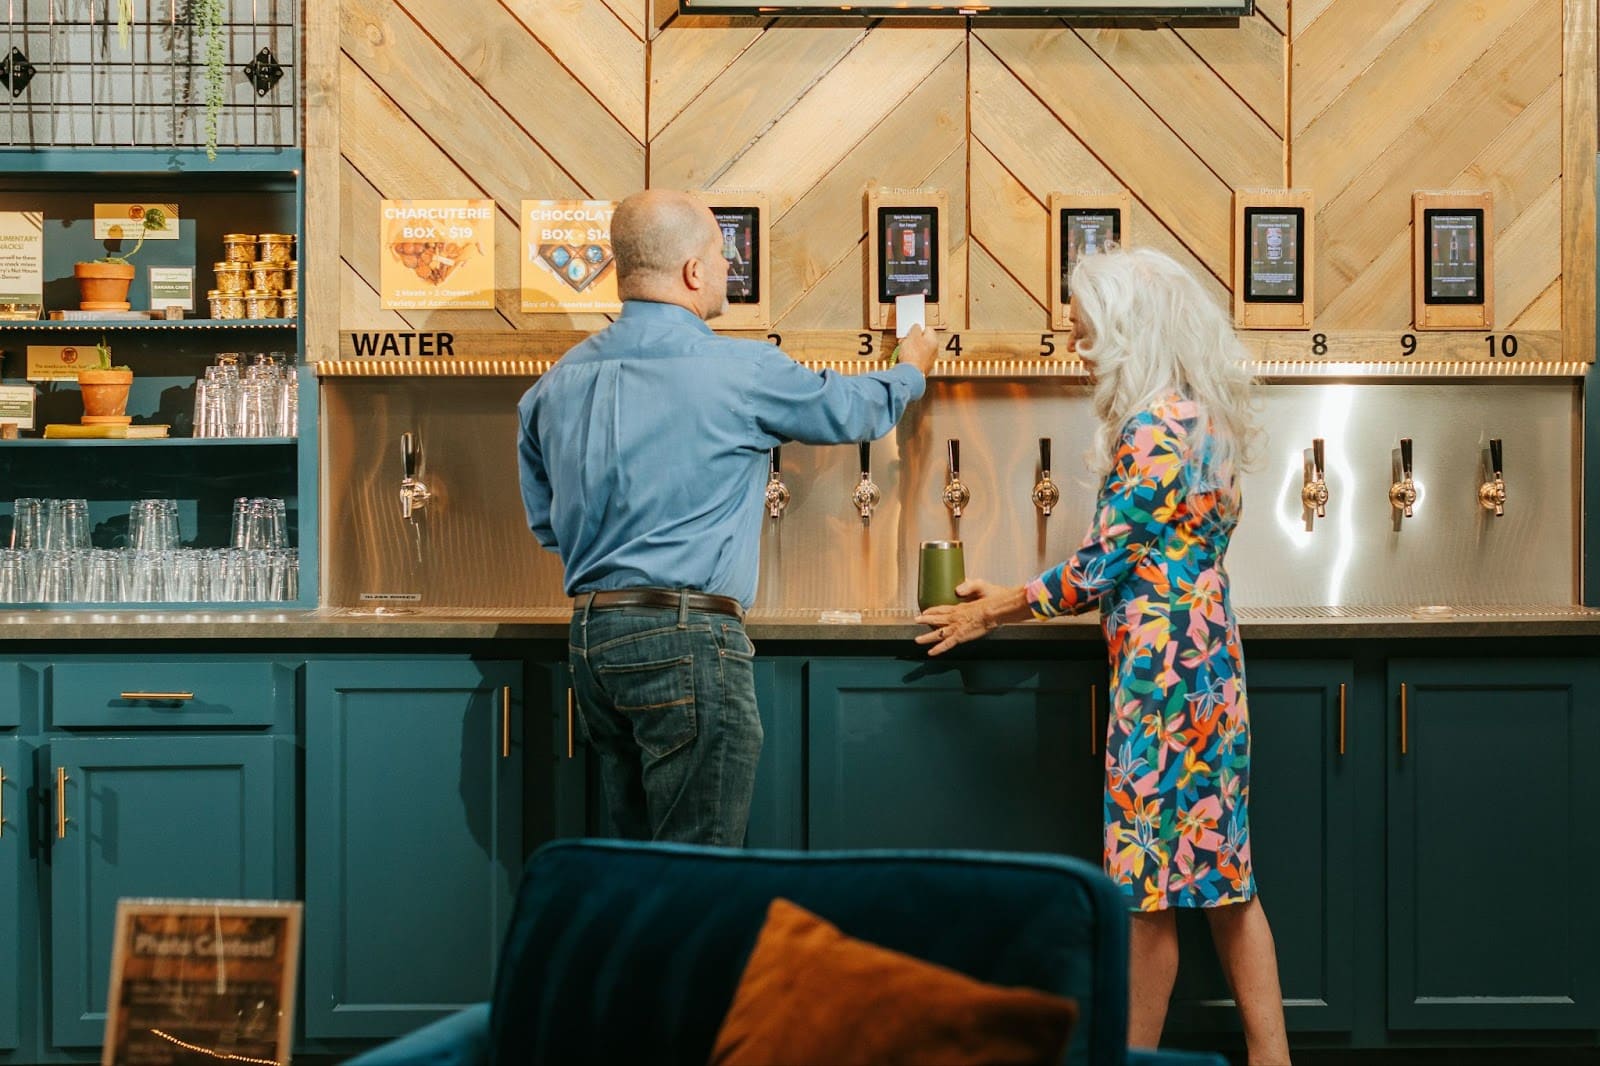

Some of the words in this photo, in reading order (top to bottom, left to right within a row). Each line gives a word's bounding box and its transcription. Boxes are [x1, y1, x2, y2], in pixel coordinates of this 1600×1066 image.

[384, 208, 491, 219] CHARCUTERIE
[530, 210, 615, 221] CHOCOLAT
[403, 227, 434, 238] BOX
[449, 225, 473, 239] $19
[542, 229, 573, 240] BOX
[386, 300, 417, 308] Variety
[352, 333, 455, 356] WATER
[858, 333, 873, 356] 3
[945, 334, 963, 357] 4
[1039, 333, 1055, 357] 5
[1312, 333, 1328, 356] 8
[1400, 333, 1417, 357] 9
[1485, 334, 1519, 357] 10
